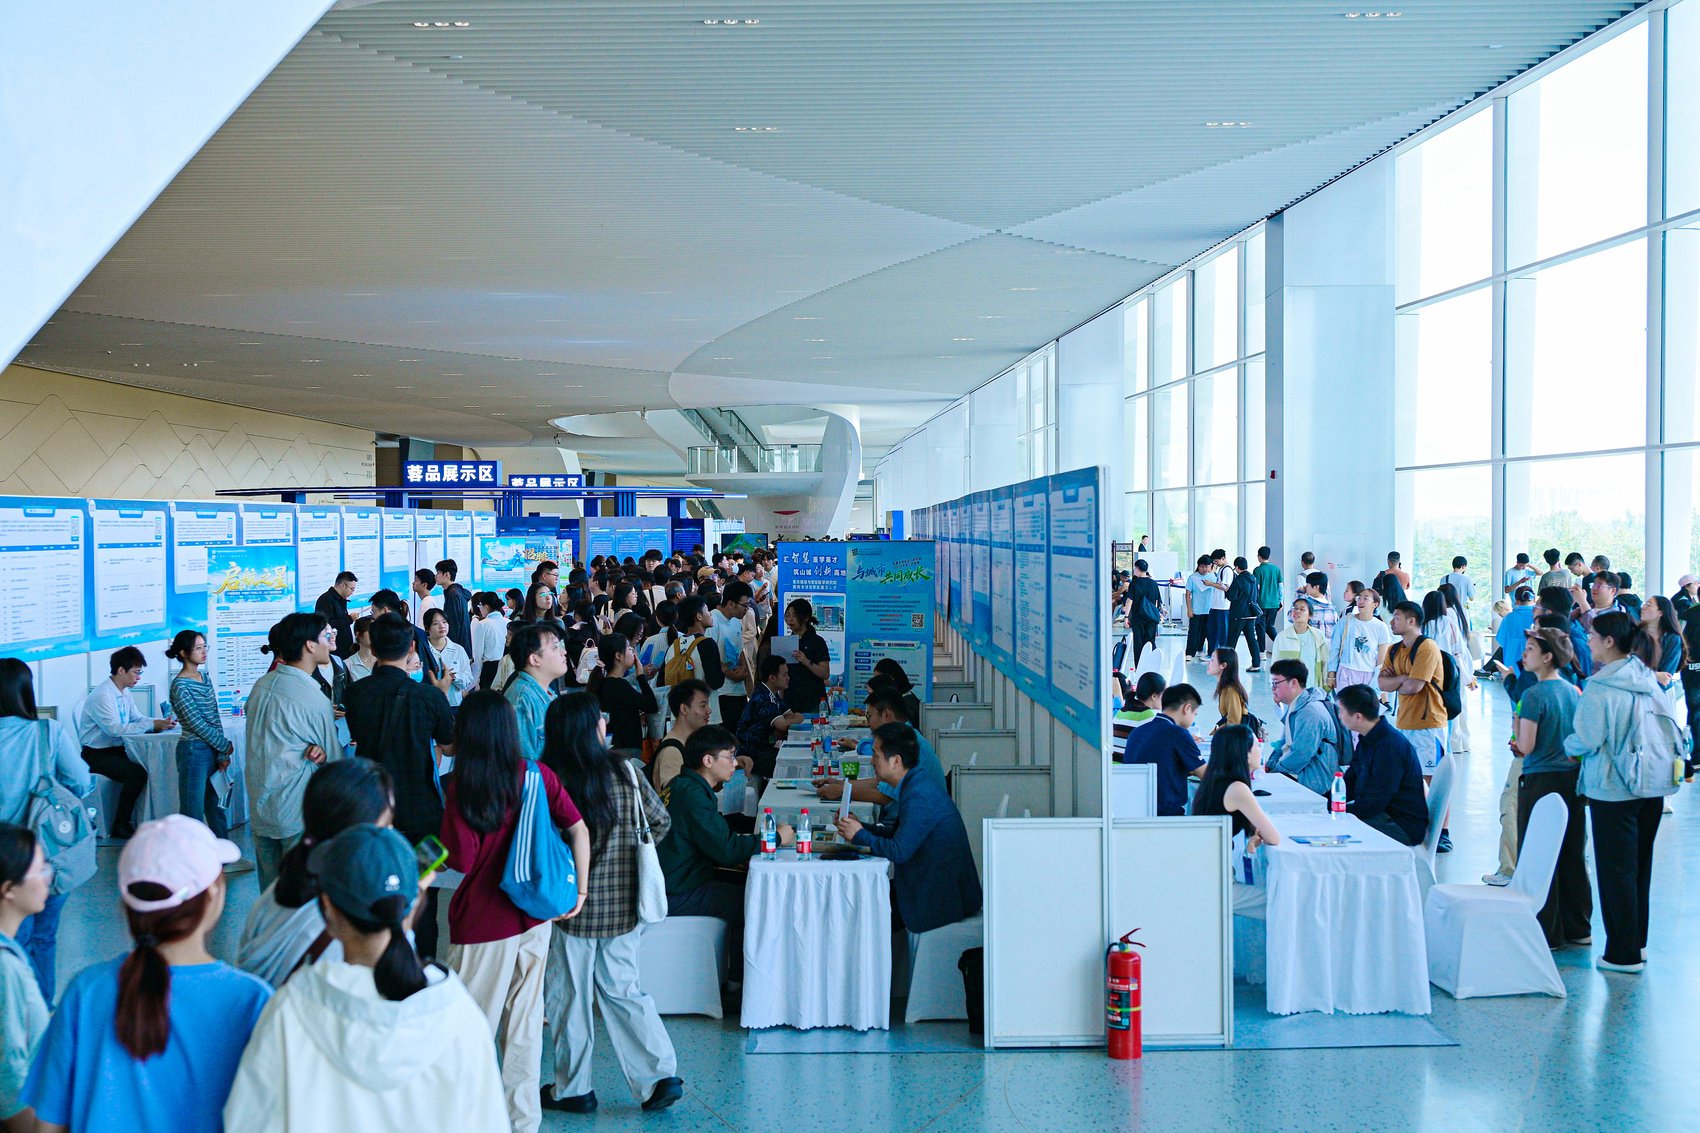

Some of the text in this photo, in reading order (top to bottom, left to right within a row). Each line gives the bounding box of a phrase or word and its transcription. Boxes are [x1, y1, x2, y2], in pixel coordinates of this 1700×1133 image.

[406, 465, 494, 482] 蓉品展示区
[852, 563, 932, 584] 与城市共同成长
